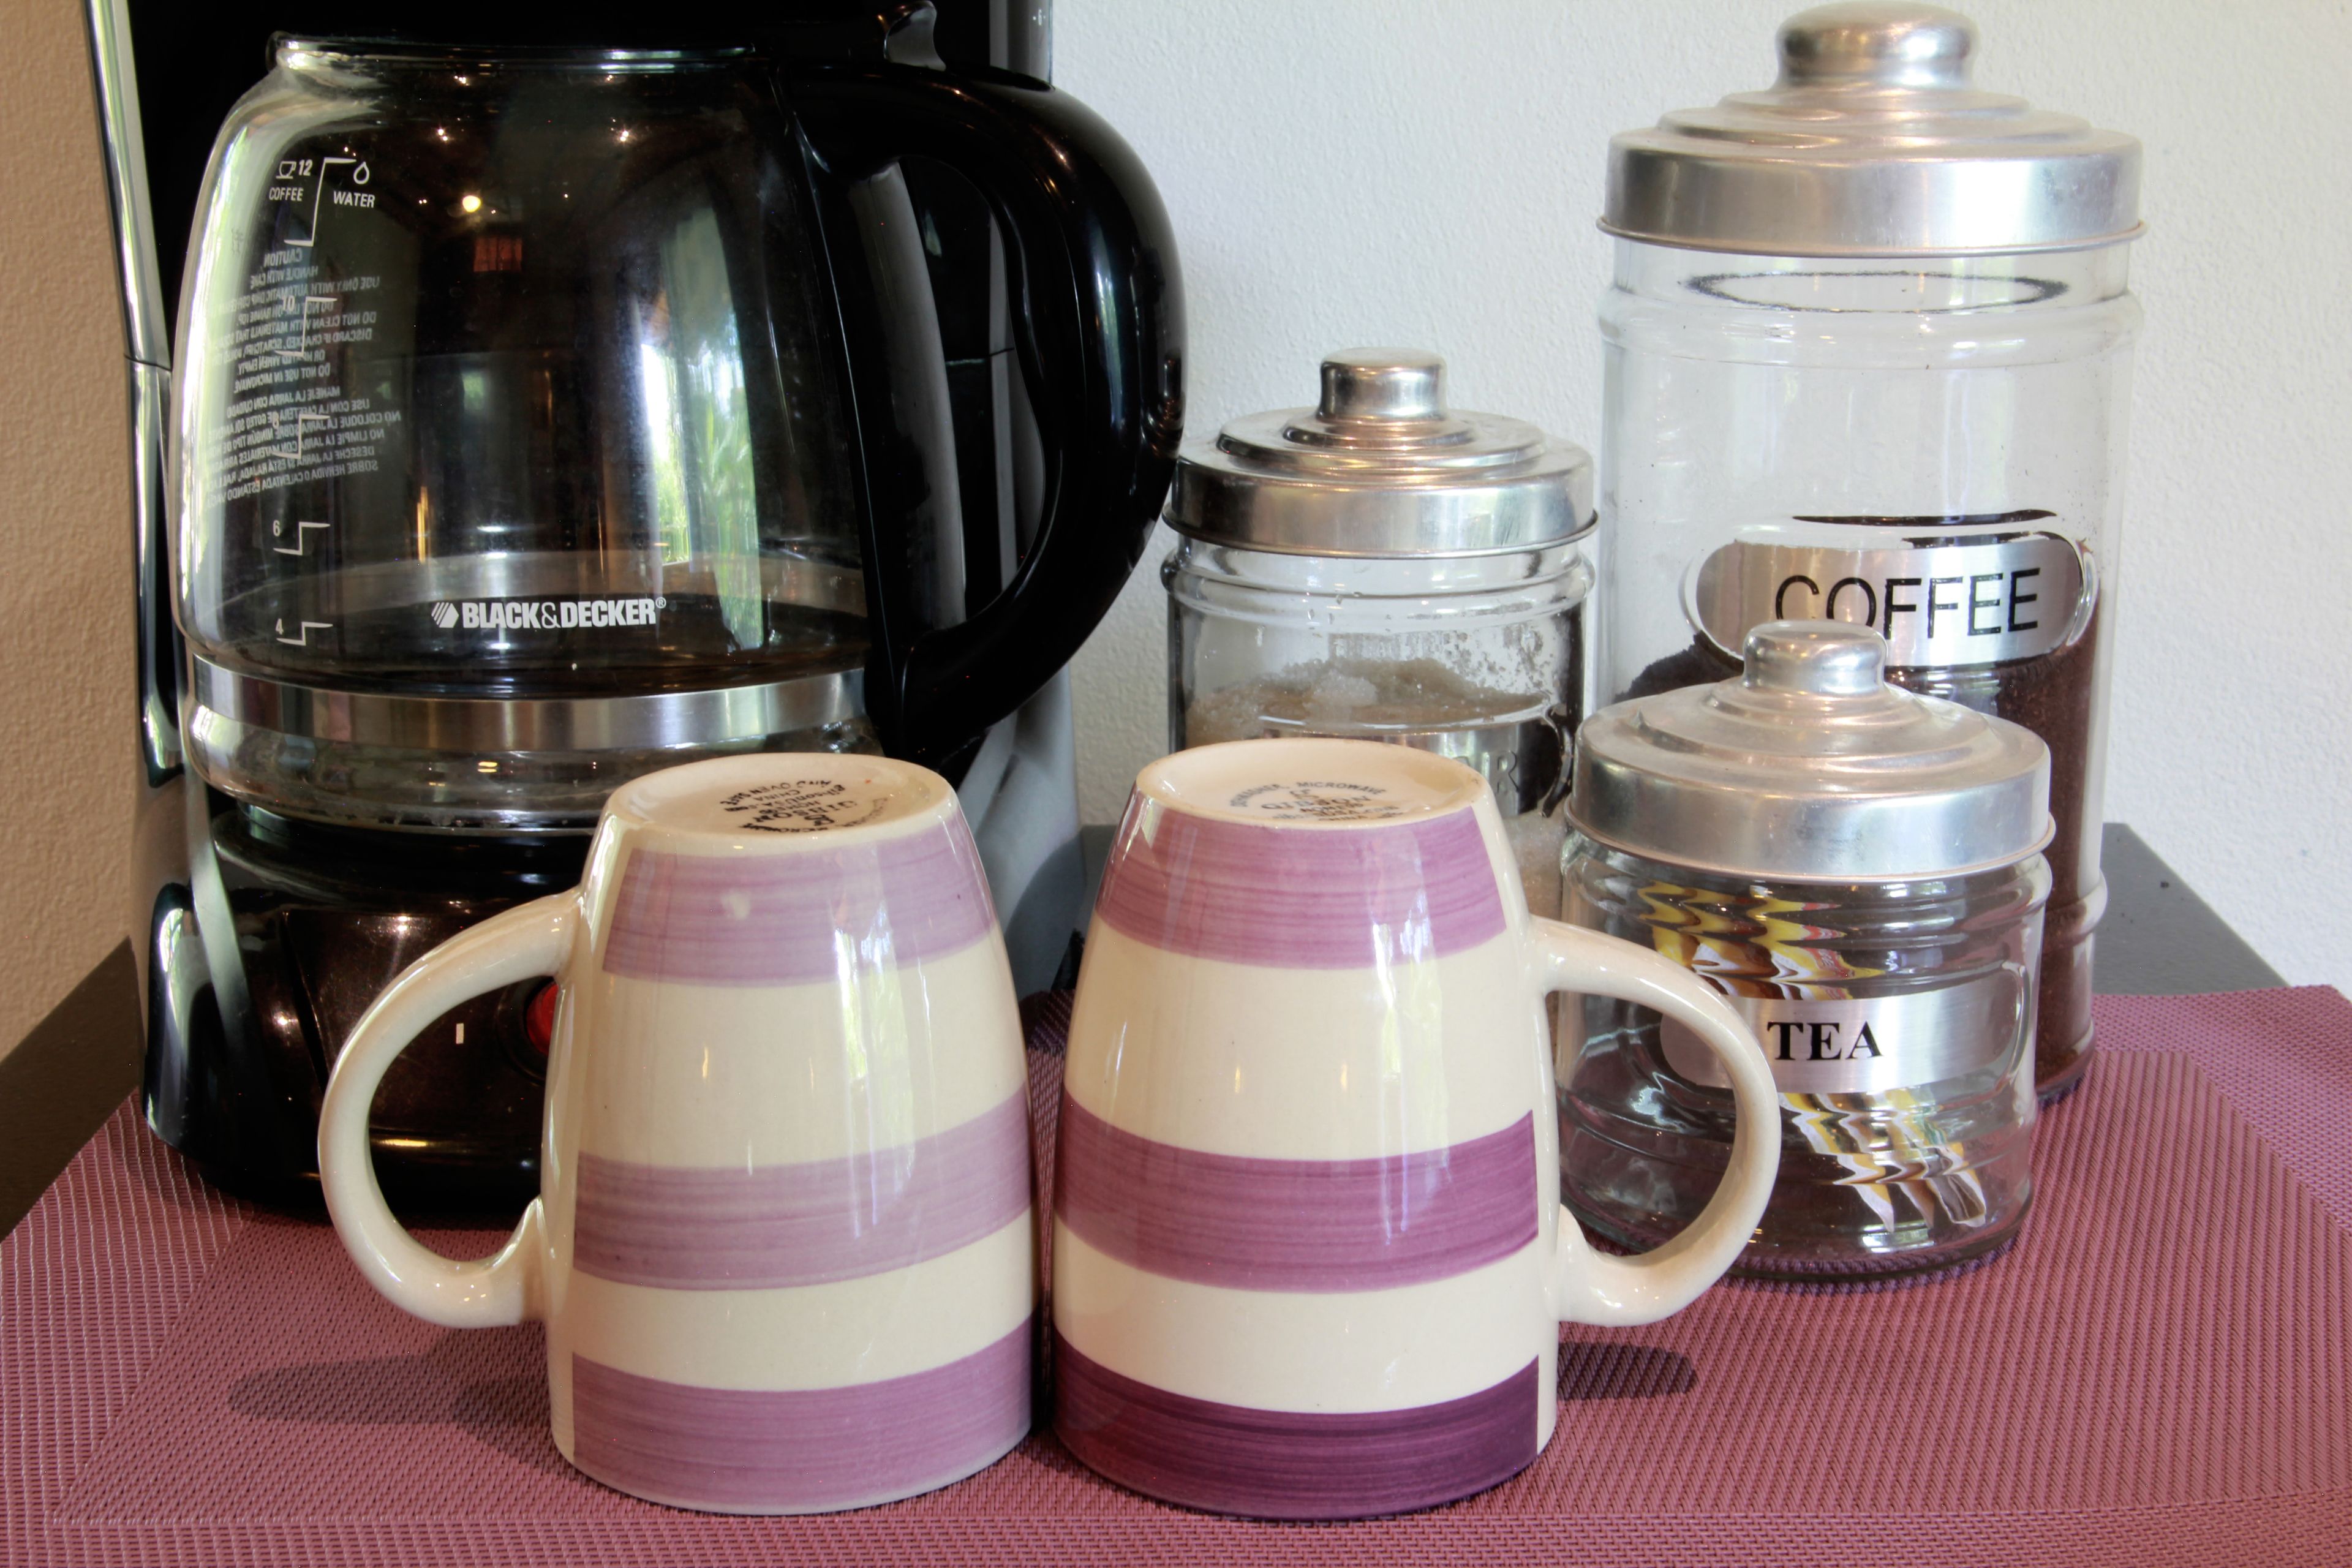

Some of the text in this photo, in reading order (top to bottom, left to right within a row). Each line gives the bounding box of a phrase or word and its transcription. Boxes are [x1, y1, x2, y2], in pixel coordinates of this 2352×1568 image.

[298, 159, 313, 176] 12
[269, 187, 304, 202] COFFEE
[333, 190, 375, 208] WATER
[283, 295, 296, 312] 10
[273, 520, 281, 537] 6
[1776, 568, 2041, 640] COFFEE
[275, 617, 283, 635] 4
[749, 782, 791, 794] OVEN
[752, 790, 801, 802] CHINA
[1766, 1020, 1883, 1060] TEA
